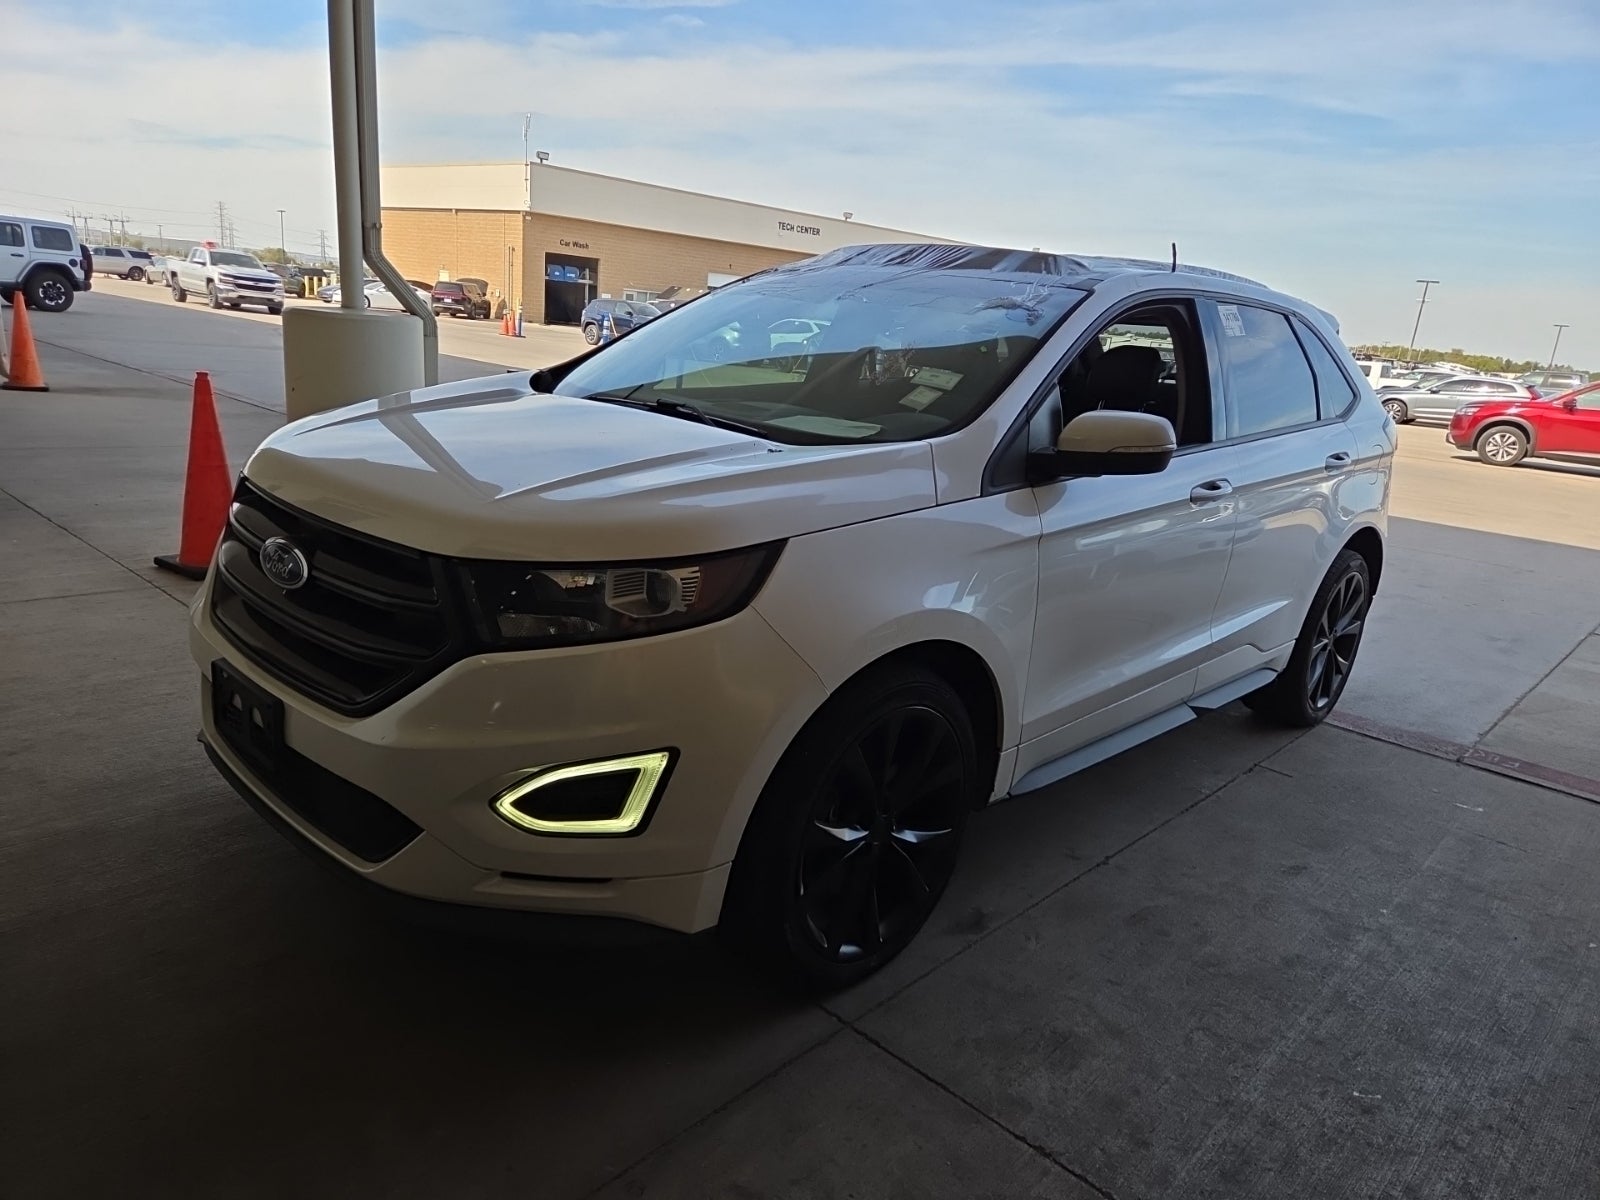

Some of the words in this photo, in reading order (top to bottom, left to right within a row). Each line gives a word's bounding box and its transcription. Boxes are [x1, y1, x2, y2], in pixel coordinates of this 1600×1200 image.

[778, 221, 794, 232] TECH
[796, 225, 821, 236] CENTER
[559, 239, 571, 247] Car
[572, 240, 590, 249] Wash
[264, 549, 293, 579] Ford
